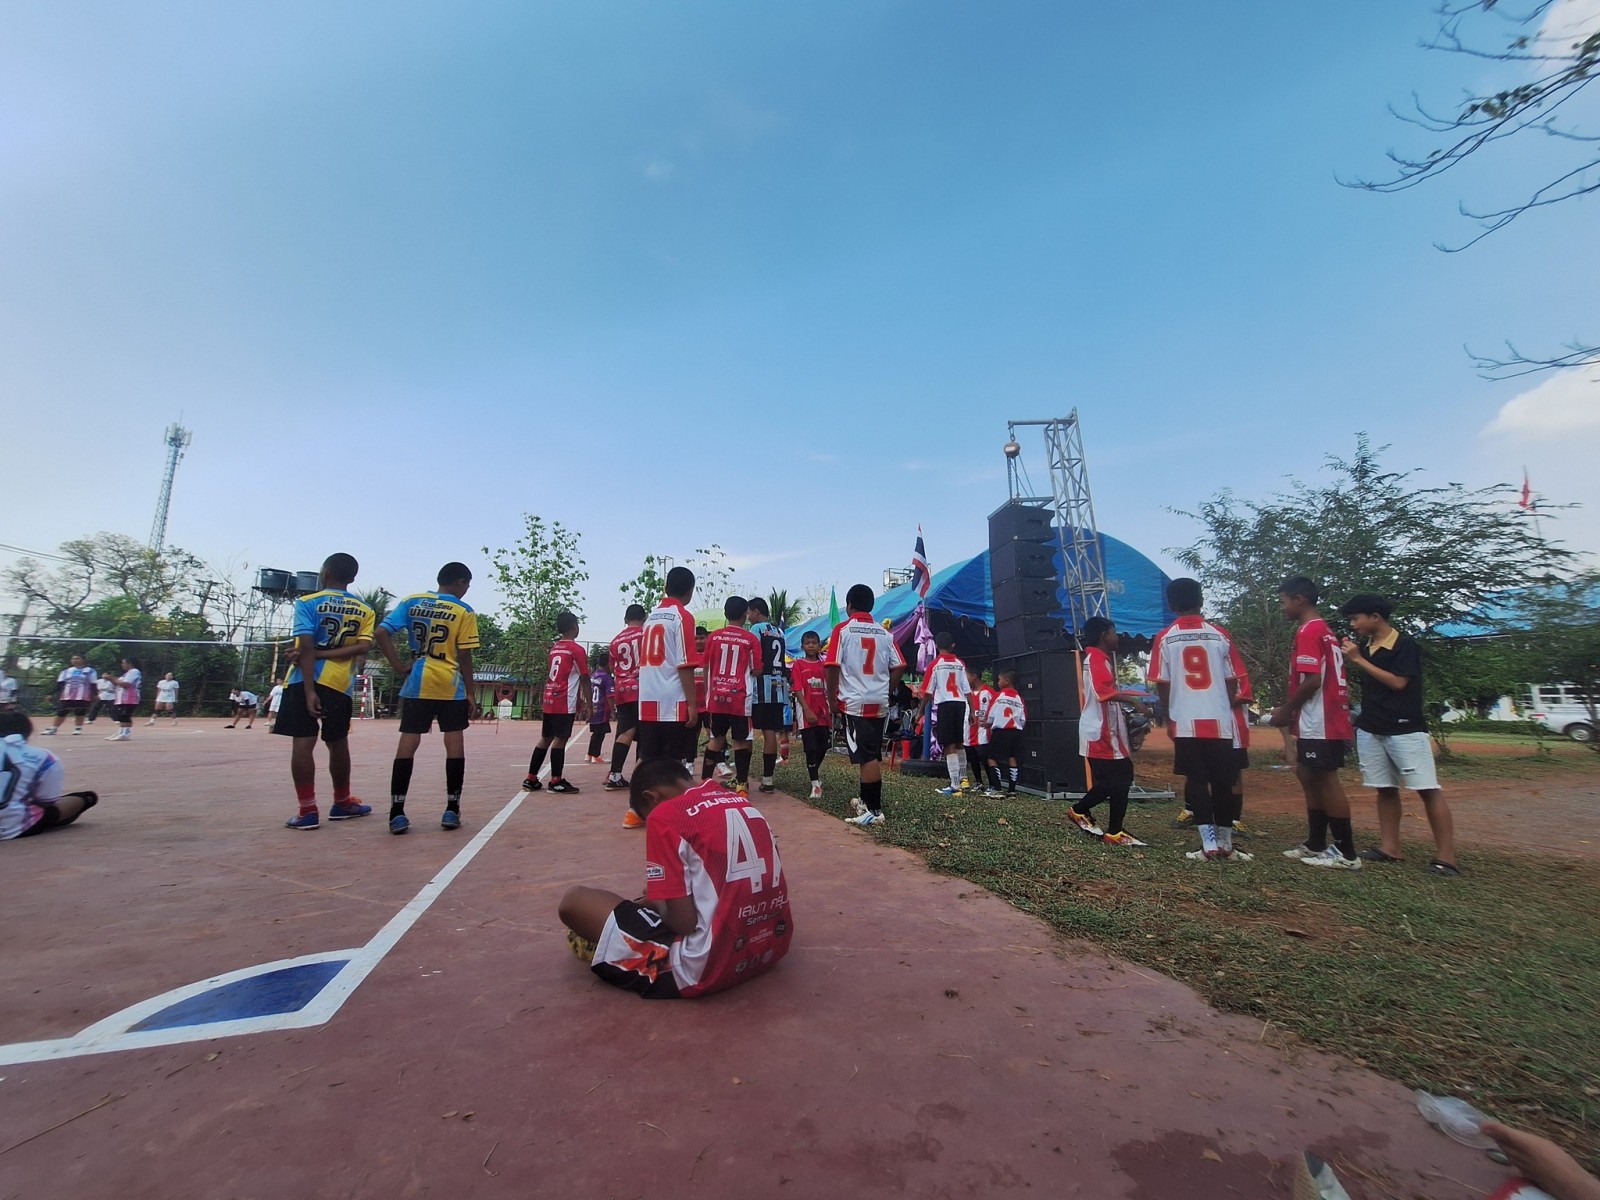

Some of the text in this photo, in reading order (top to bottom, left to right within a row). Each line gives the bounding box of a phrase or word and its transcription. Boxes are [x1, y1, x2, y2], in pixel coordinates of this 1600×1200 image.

[318, 602, 367, 618] บ้านเสมา
[329, 596, 361, 607] โรงเรียน
[409, 605, 457, 622] บ้านเสมา
[421, 600, 453, 611] โรงเรียน
[316, 616, 360, 650] 32
[411, 621, 449, 660] 32
[640, 624, 666, 667] 10
[548, 655, 562, 682] 6
[617, 639, 641, 671] 31
[719, 643, 740, 676] 11
[771, 639, 783, 667] 2
[861, 636, 876, 676] 7
[1181, 645, 1212, 691] 9
[946, 672, 960, 698] 4
[725, 806, 783, 894] 47
